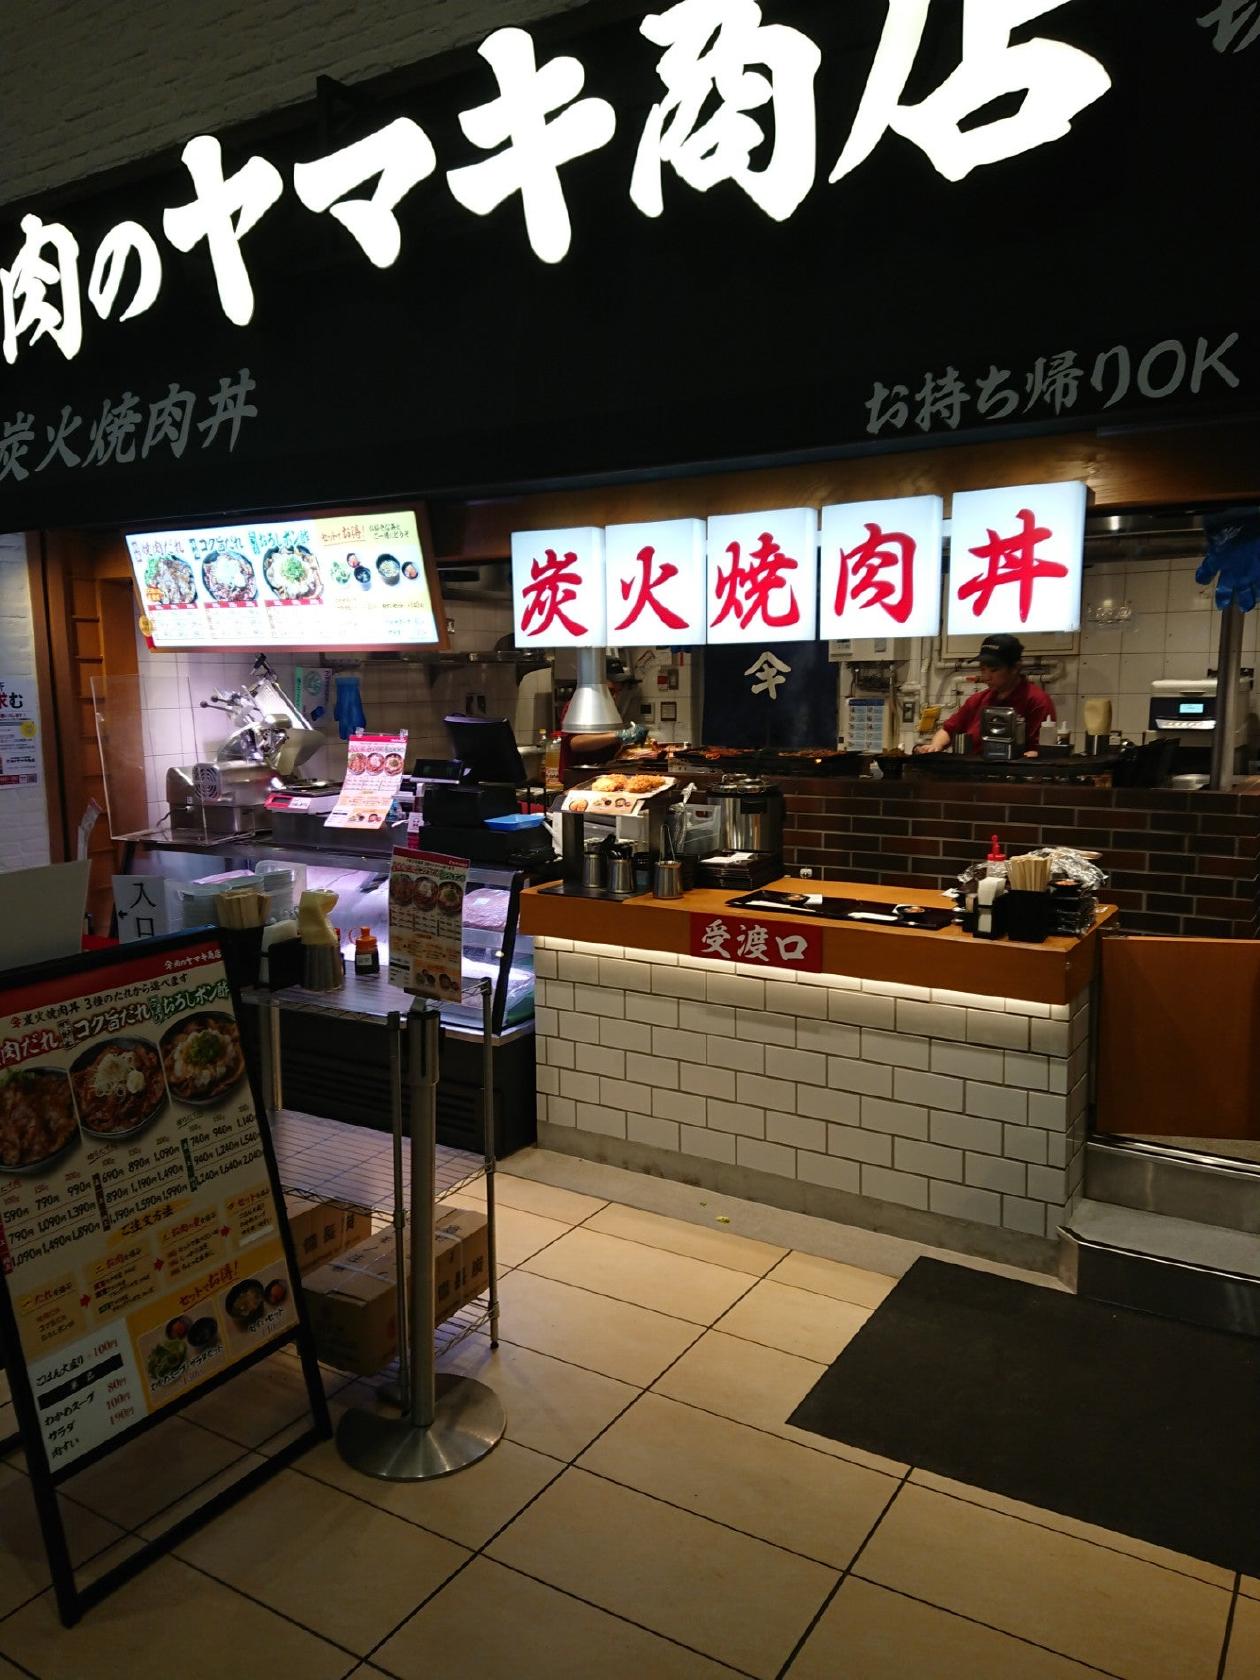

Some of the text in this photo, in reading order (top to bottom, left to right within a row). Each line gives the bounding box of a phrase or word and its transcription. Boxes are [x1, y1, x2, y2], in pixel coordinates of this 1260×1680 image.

[0, 0, 1112, 363] 肉のヤマキ商店
[0, 368, 258, 482] 炭火焼肉丼
[864, 332, 1241, 434] お持ち帰りOK
[520, 508, 1069, 637] 炭火焼肉丼
[130, 882, 157, 938] 入口
[700, 919, 808, 962] 受渡口
[0, 1030, 60, 1066] 肉だれ
